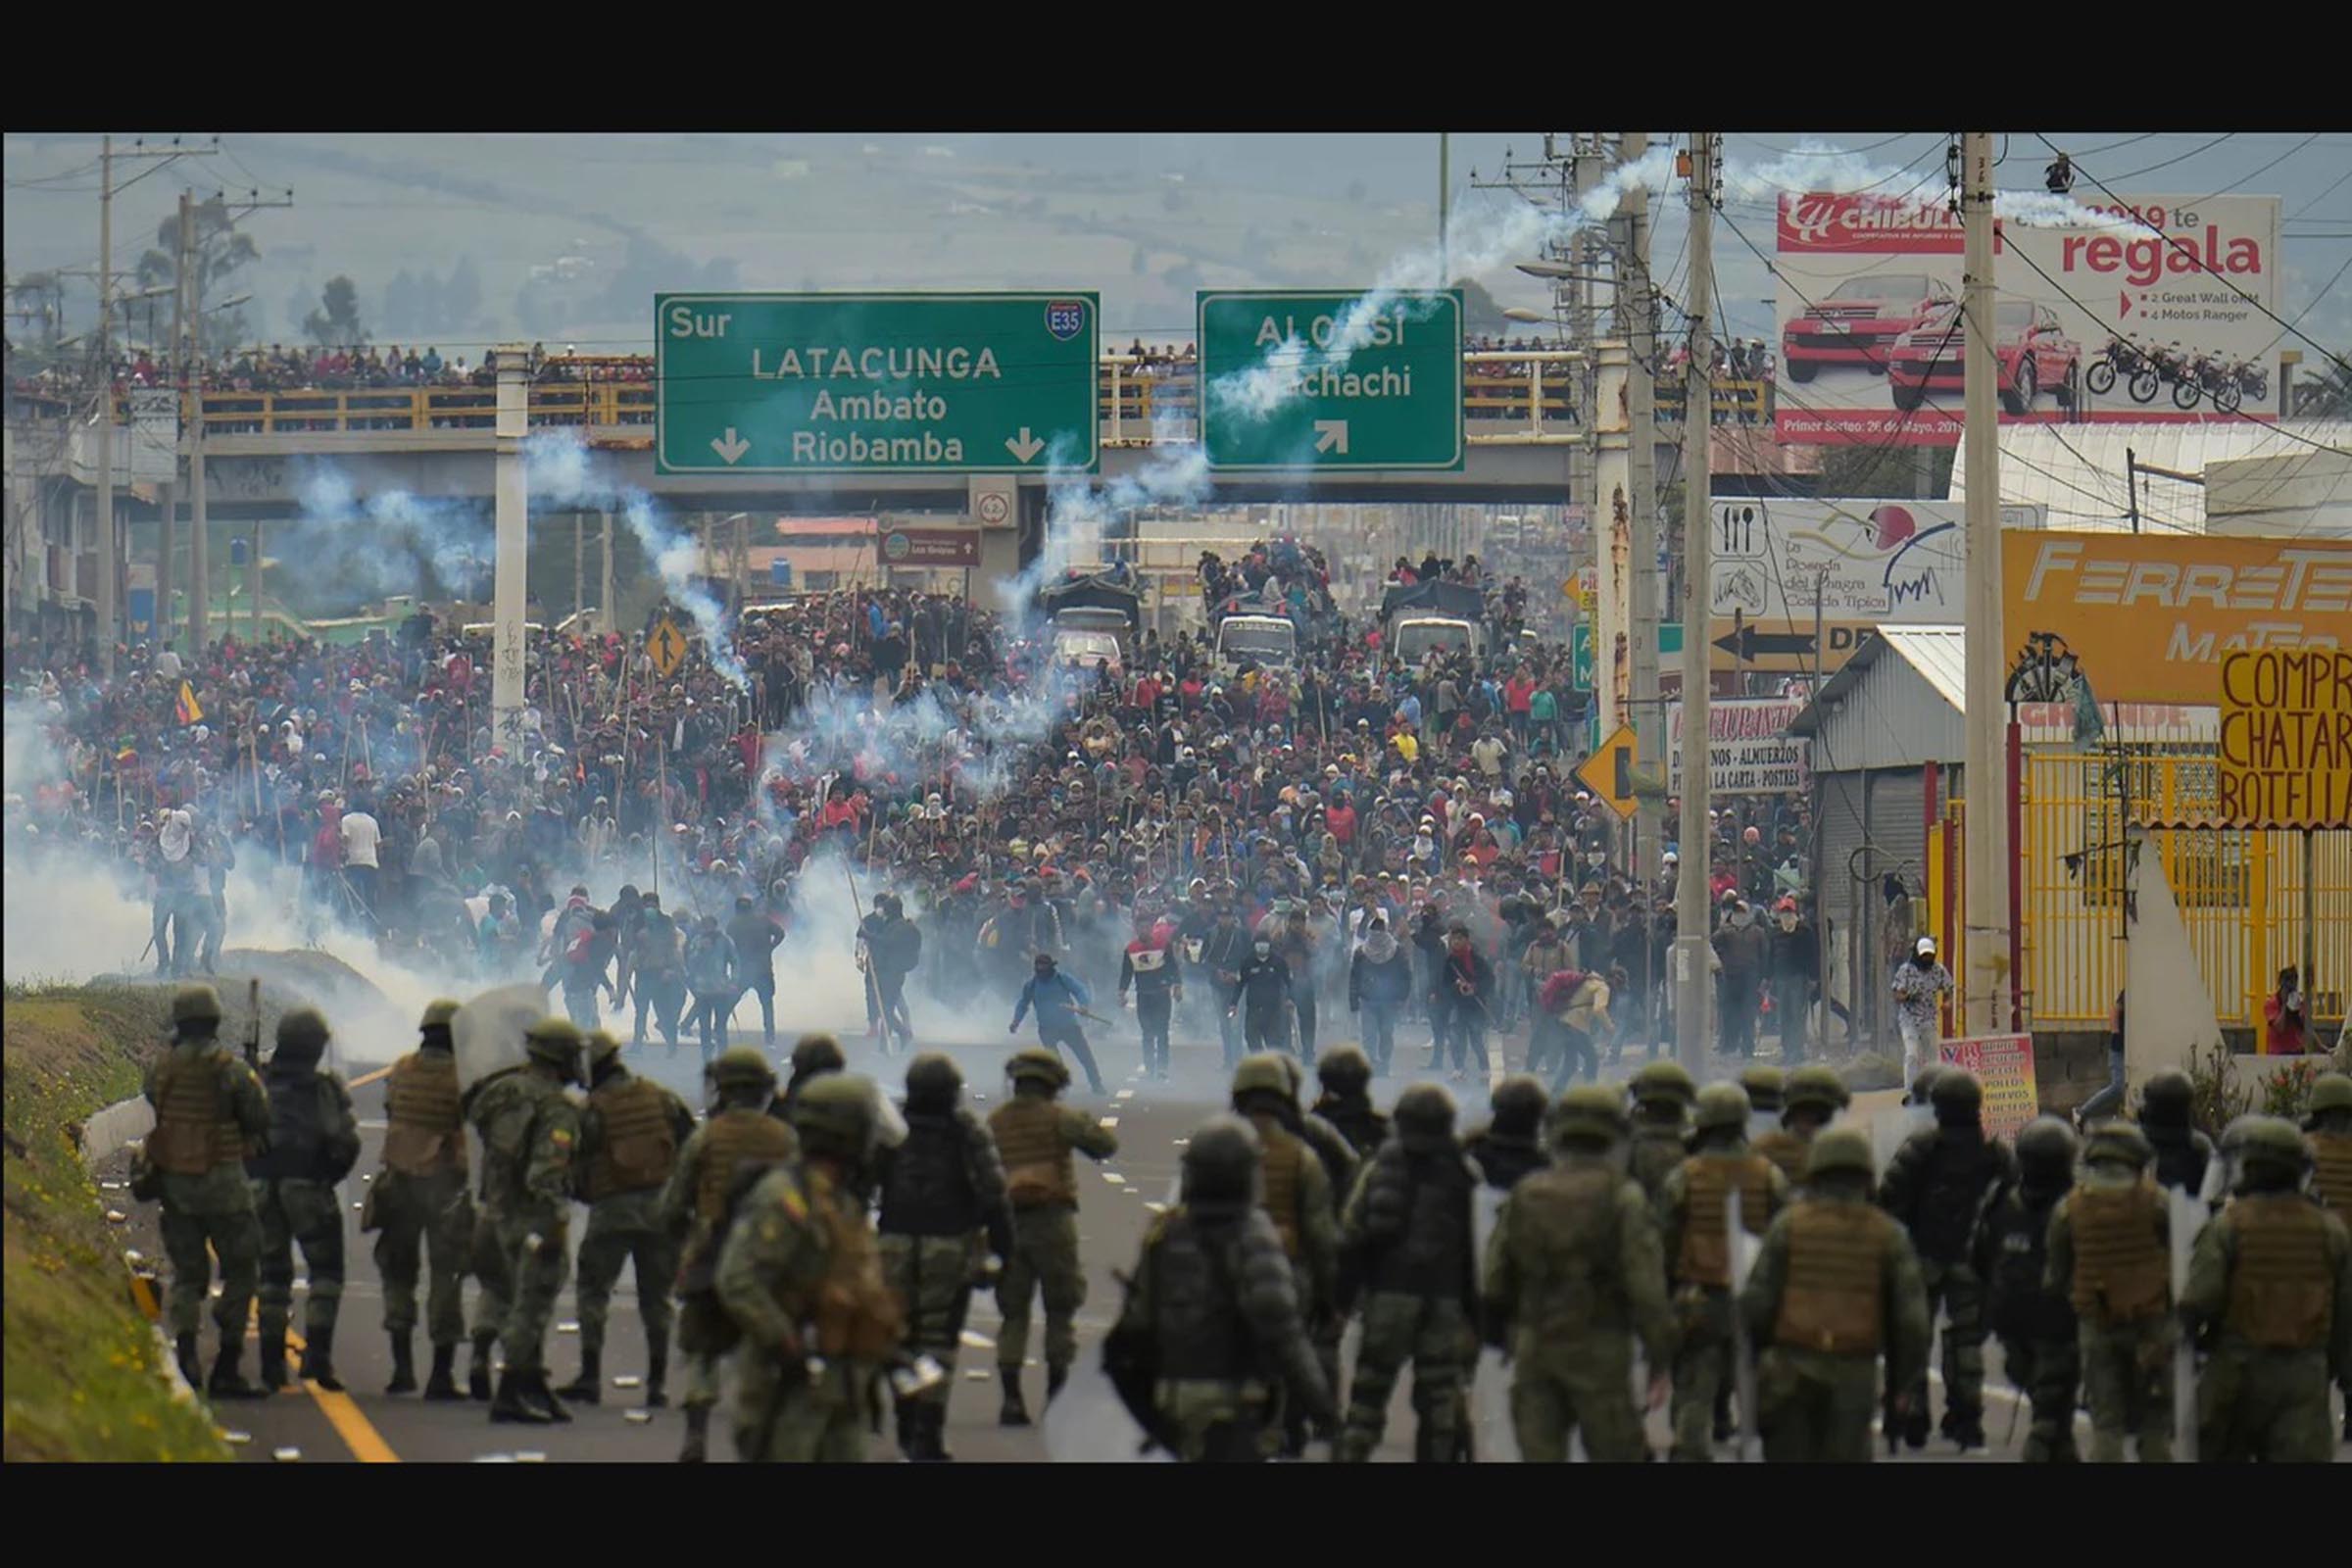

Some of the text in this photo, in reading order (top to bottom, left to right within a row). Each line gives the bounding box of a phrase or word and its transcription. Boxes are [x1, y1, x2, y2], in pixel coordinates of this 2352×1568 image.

[2174, 208, 2199, 228] te
[2063, 225, 2262, 287] regala
[2162, 293, 2197, 304] Great
[2199, 293, 2229, 304] Wall
[670, 307, 732, 338] Sur
[1052, 312, 1079, 330] E35
[2162, 311, 2193, 320] Motos
[2197, 311, 2248, 322] Ranger
[1254, 315, 1405, 347] ALOSI
[753, 347, 1002, 380] LATACUNGA
[1264, 365, 1411, 397] chachi
[809, 390, 948, 421] Ambato
[1784, 419, 1822, 432] Primer
[793, 431, 964, 463] Riobamba
[1785, 576, 1809, 589] del
[1739, 746, 1799, 765] ALMUERZOS
[1728, 769, 1756, 789] CARTA
[1762, 768, 1800, 788] POSTRES
